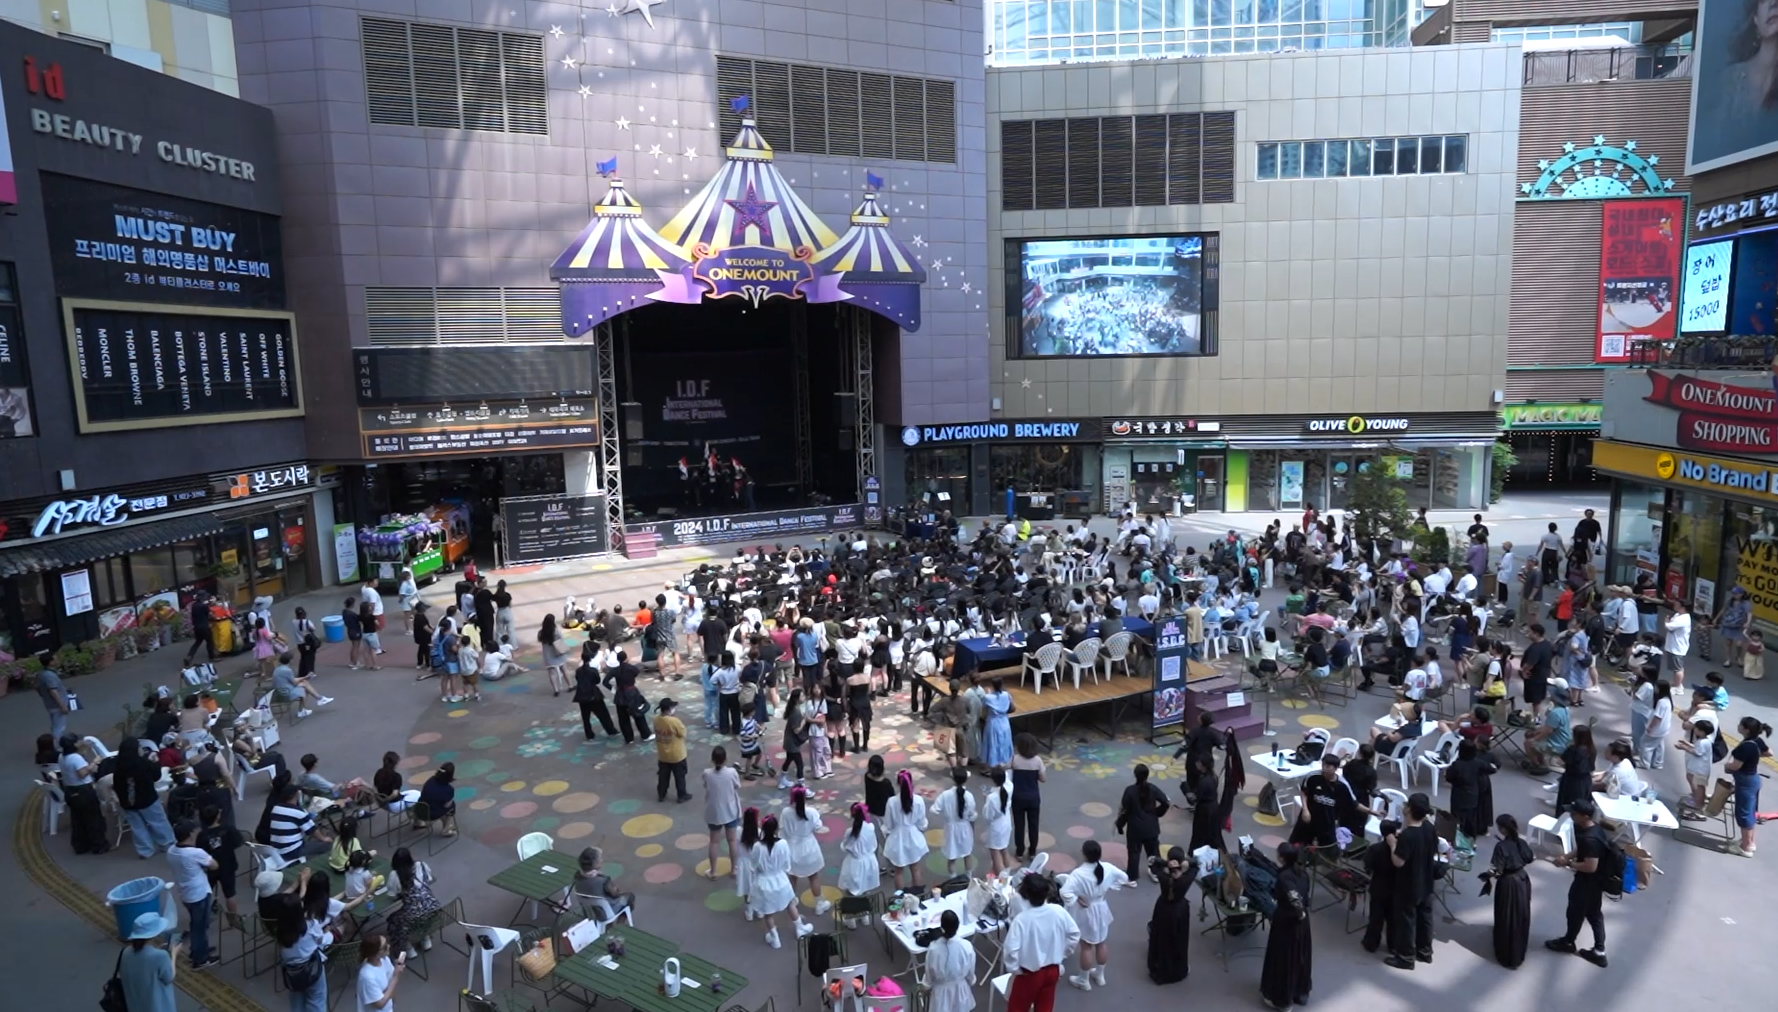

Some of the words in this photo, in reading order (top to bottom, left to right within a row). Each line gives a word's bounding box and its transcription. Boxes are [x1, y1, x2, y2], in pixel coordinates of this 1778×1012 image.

[24, 55, 66, 100] id
[31, 108, 143, 154] BEAUTY
[157, 141, 256, 182] CLUSTER
[1695, 199, 1757, 231] 수산요리
[114, 214, 185, 246] MUST
[190, 226, 236, 252] BUY
[75, 239, 137, 264] 프리미엄
[142, 247, 209, 272] 해외명품샵
[214, 256, 270, 279] 머스트바이
[708, 267, 799, 282] ONEMOUNT
[724, 258, 769, 268] WELCOME
[771, 259, 785, 268] TO
[1689, 300, 1720, 321] 15000
[98, 328, 112, 378] MONCLER
[125, 329, 137, 362] THOM
[174, 331, 187, 374] BOTTEGA
[198, 331, 208, 362] STONE
[239, 332, 249, 359] SAINT
[258, 333, 267, 350] OFF
[275, 333, 285, 367] GOLDEN
[150, 330, 165, 391] BALENCIAGA
[219, 332, 231, 383] VALENTINO
[261, 351, 271, 379] WHITE
[129, 362, 143, 406] BROWNE
[201, 362, 212, 397] ISLAND
[242, 359, 253, 400] LAURENT
[278, 368, 288, 397] GOOSE
[359, 355, 373, 398] 행사안내
[677, 380, 711, 398] I.D.F
[178, 375, 191, 411] VENETA
[1681, 382, 1776, 413] ONEMOUNT
[1309, 419, 1346, 431] OLIVE
[1366, 418, 1408, 430] YOUNG
[1516, 408, 1569, 423] MAGIC
[923, 424, 1009, 442] PLAYGROUND
[1015, 422, 1080, 438] BREWERY
[1693, 420, 1771, 446] SHOPPING
[252, 465, 310, 493] 본도시락
[1680, 459, 1705, 481] No
[1708, 463, 1768, 492] Brand
[130, 495, 168, 512] 전문점
[673, 520, 703, 535] 2024
[706, 518, 731, 532] I.D.F
[731, 519, 778, 529] INTERNATIONAL
[779, 516, 799, 525] DANCE
[800, 514, 827, 523] FESTIVAL
[1737, 558, 1759, 570] PAY
